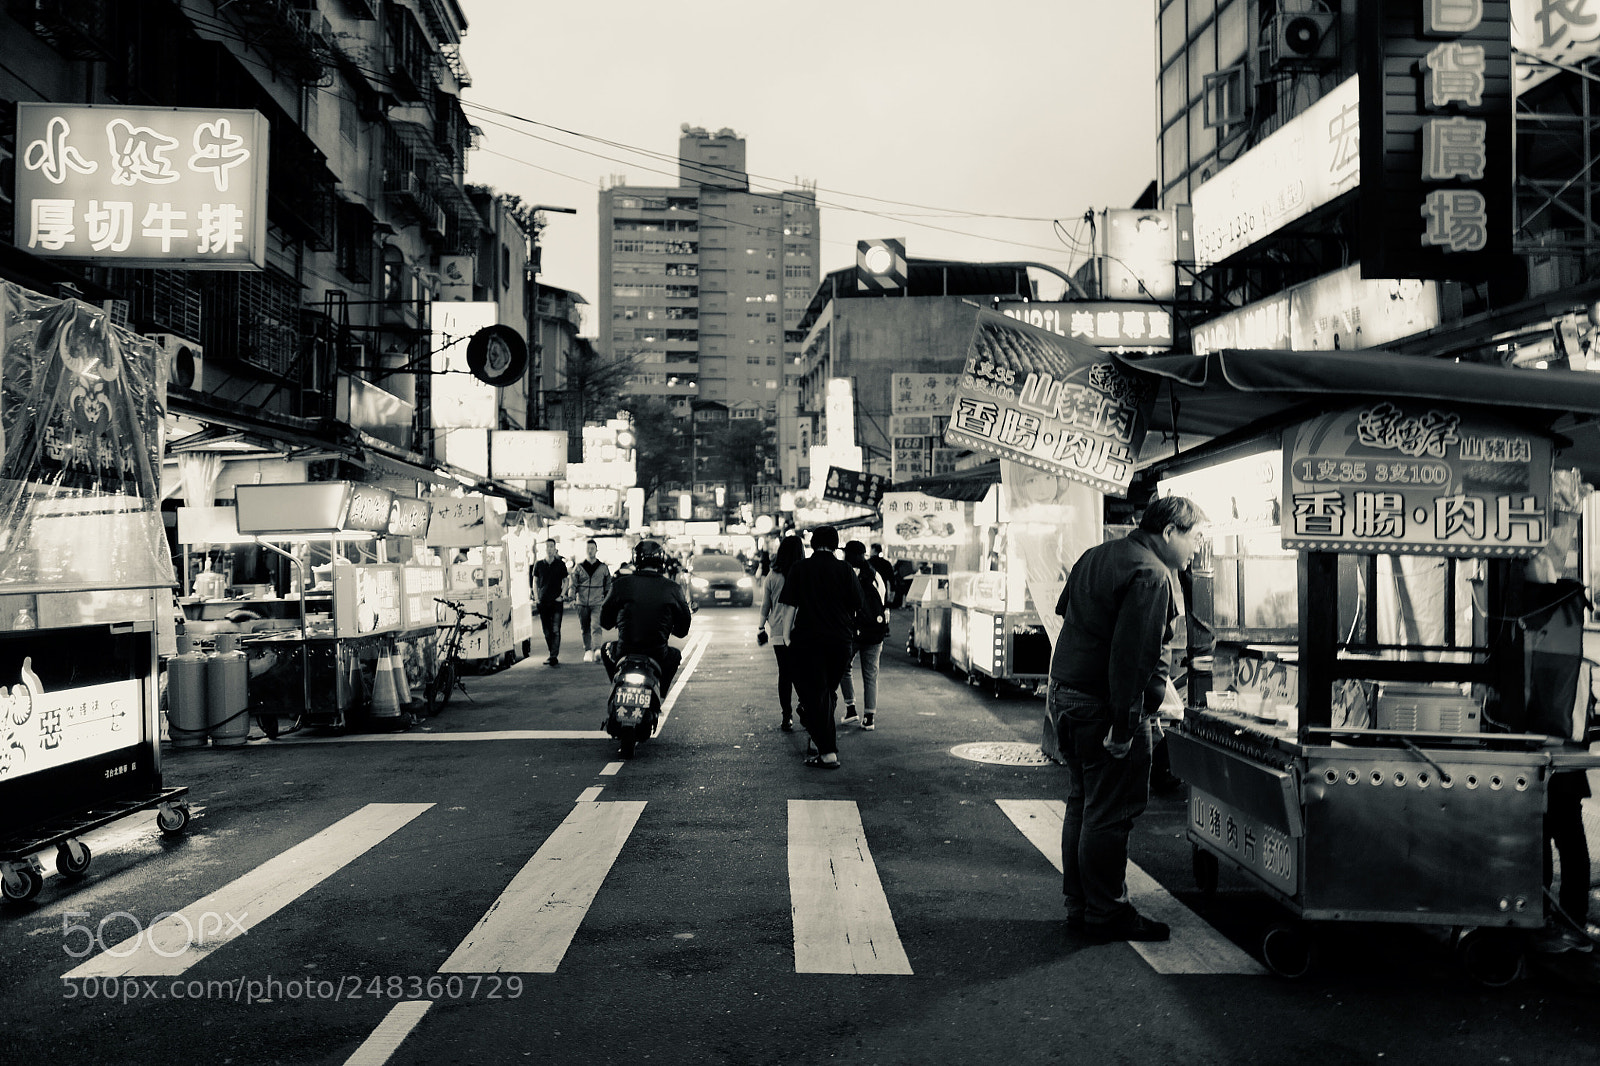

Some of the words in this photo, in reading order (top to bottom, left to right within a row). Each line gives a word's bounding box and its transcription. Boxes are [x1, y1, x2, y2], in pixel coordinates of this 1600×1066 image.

[24, 116, 250, 192] 小紅牛
[28, 198, 244, 254] 厚切牛排
[1302, 459, 1367, 483] 1支35
[1374, 462, 1447, 484] 3支100
